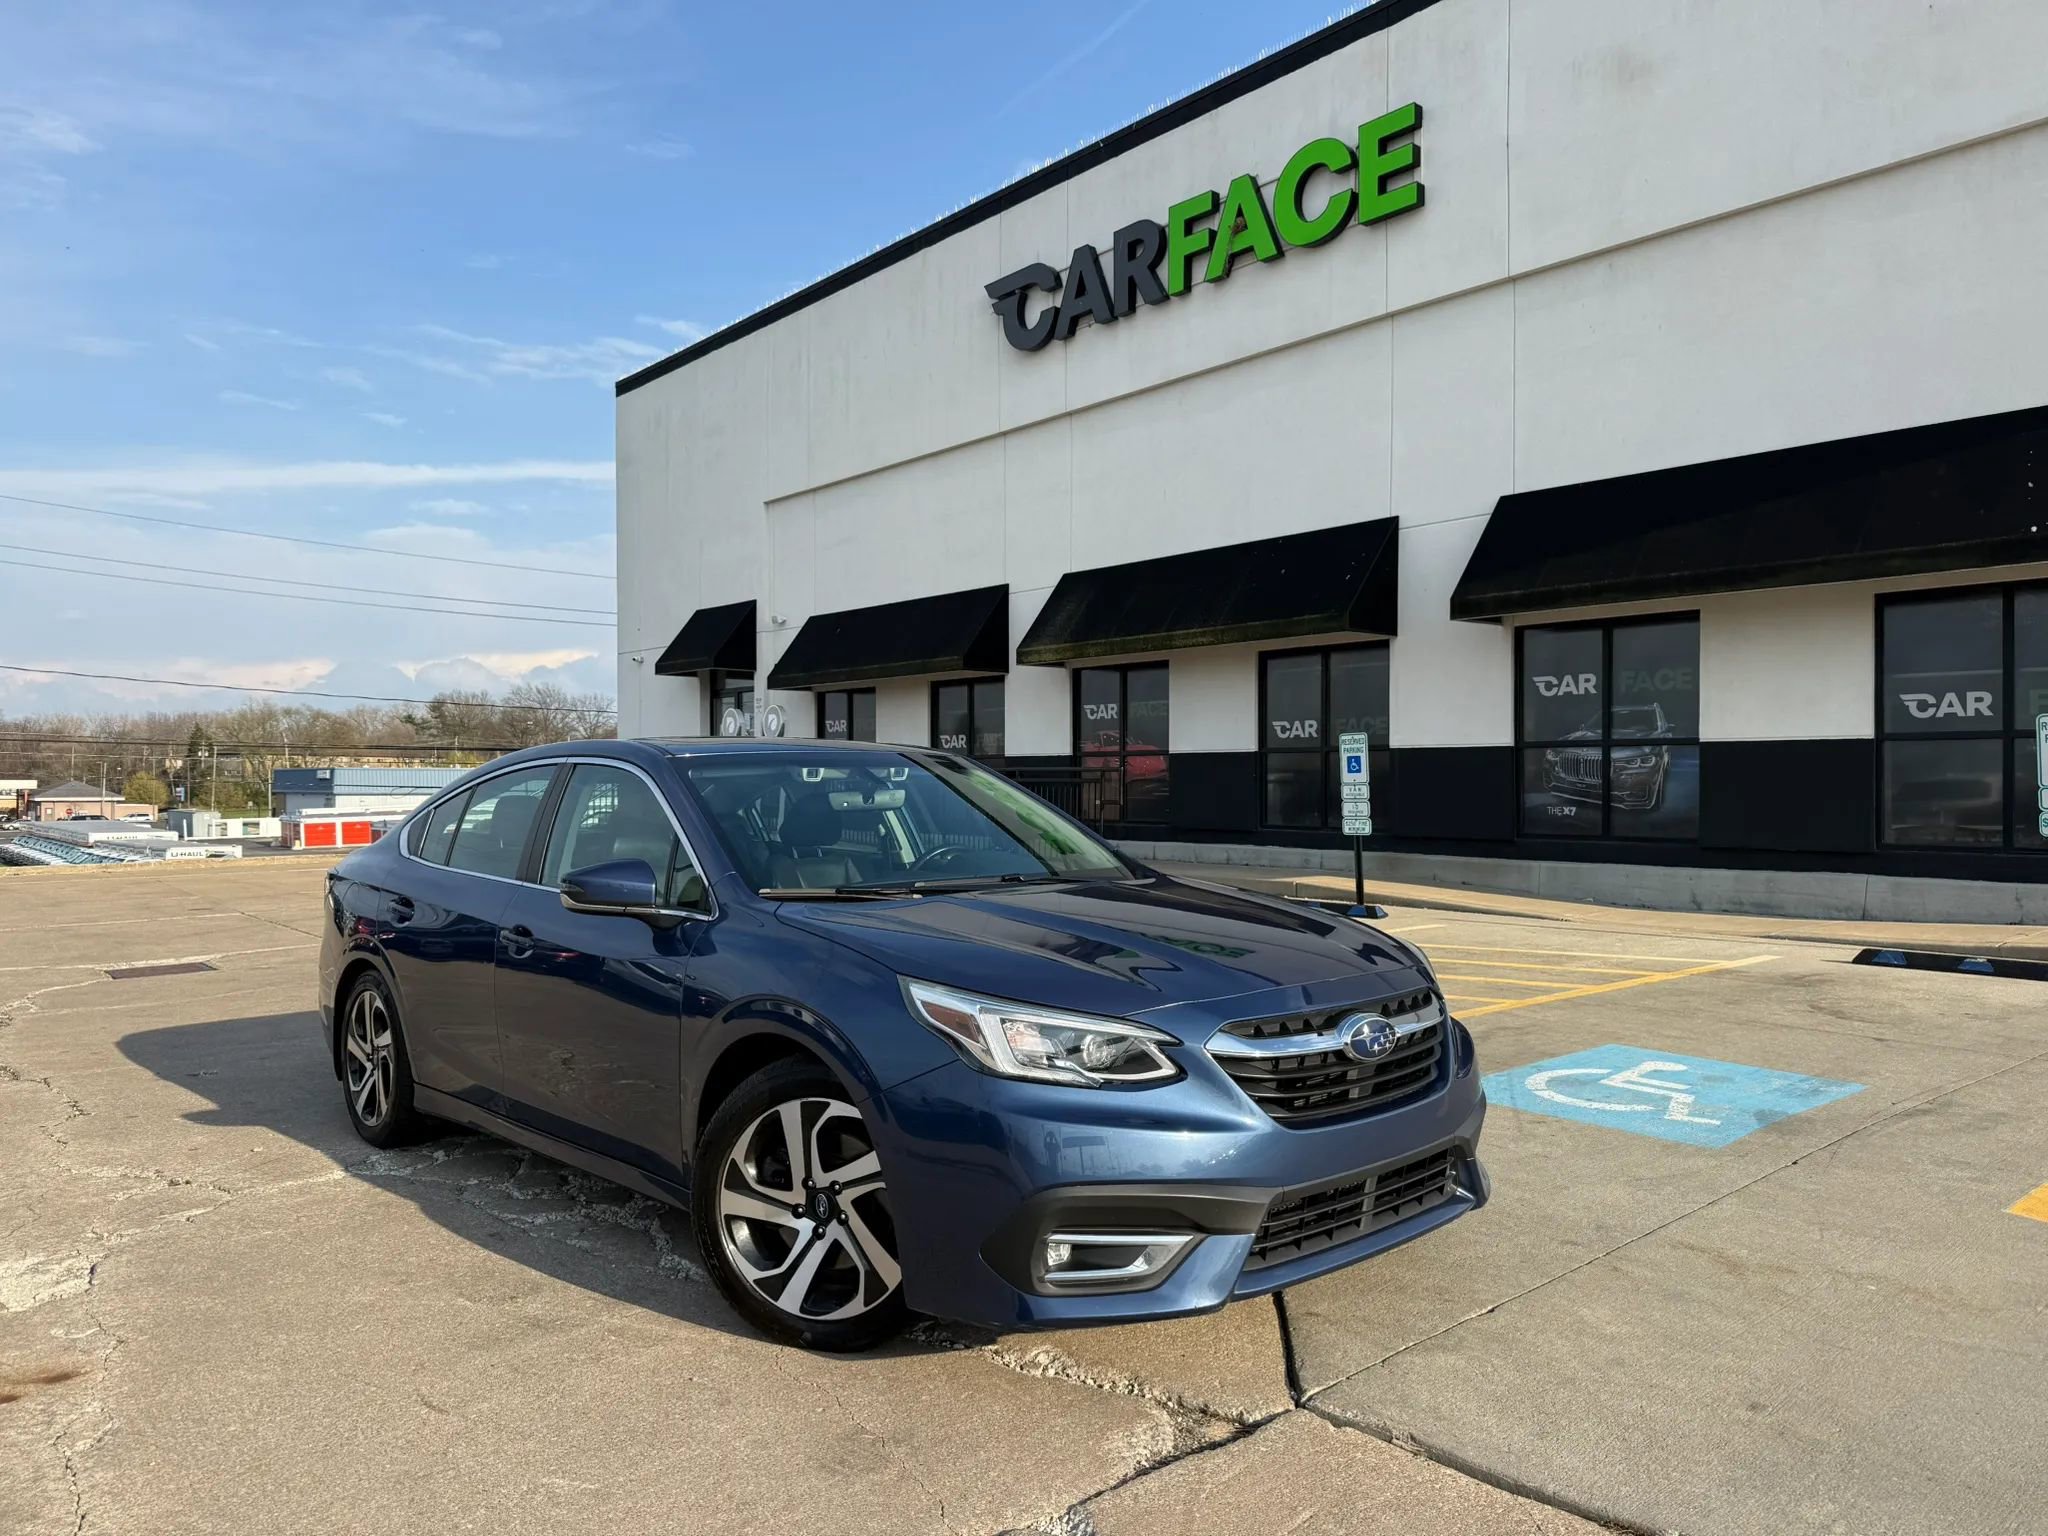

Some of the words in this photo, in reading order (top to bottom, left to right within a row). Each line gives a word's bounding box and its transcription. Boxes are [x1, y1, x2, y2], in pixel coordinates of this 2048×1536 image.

[984, 101, 1425, 352] CARFACE
[1532, 673, 1598, 697] CAR
[1620, 667, 1693, 694] FACE
[1083, 703, 1118, 720] CAR
[1899, 691, 1994, 719] CAR
[825, 719, 847, 733] CAR
[1272, 719, 1319, 739] CAR
[939, 734, 967, 749] CAR
[1547, 806, 1562, 816] THE
[1562, 806, 1577, 816] X7
